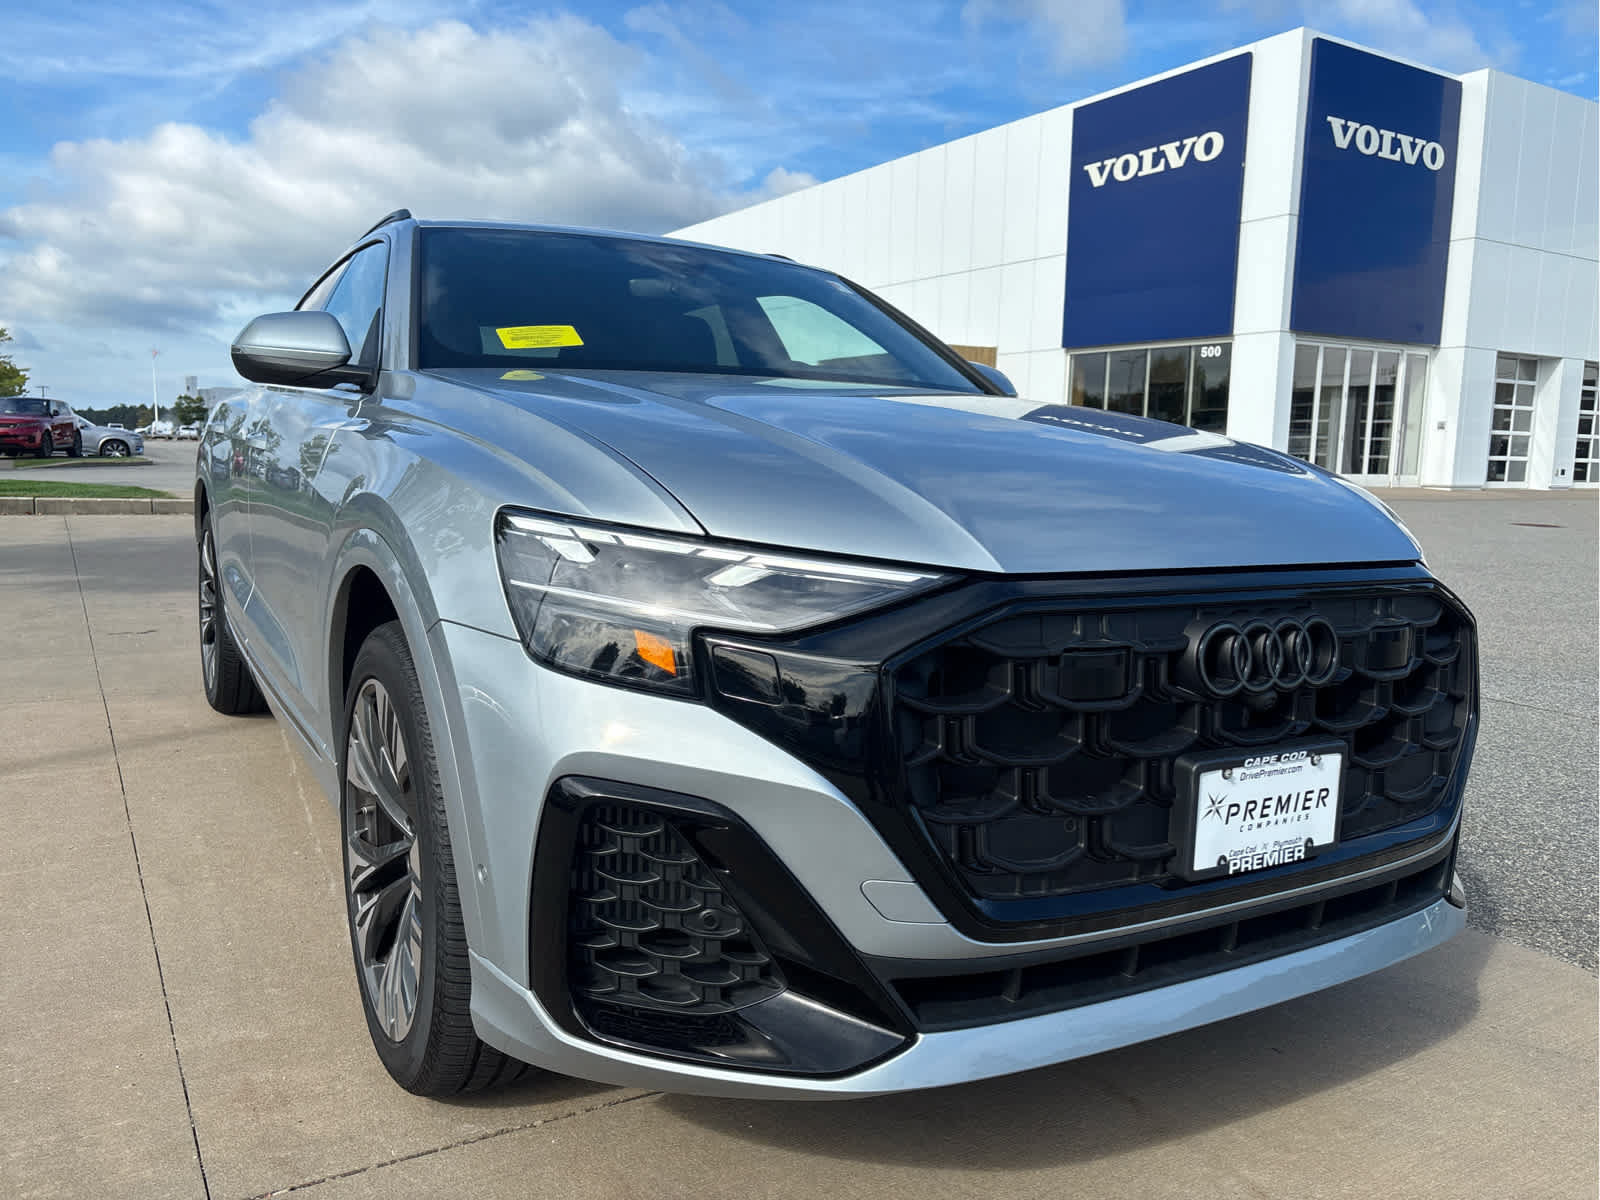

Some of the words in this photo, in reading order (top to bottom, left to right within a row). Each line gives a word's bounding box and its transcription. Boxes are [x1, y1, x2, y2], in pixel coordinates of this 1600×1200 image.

[1327, 115, 1445, 171] VOLVO
[1083, 131, 1225, 188] VOLVO
[1200, 345, 1221, 358] 500
[1244, 754, 1279, 768] CAPE
[1280, 750, 1308, 763] COD
[1240, 765, 1303, 782] DrivePremier.com
[1225, 787, 1330, 825] PREMIER
[1240, 813, 1310, 833] COMPANIES
[1228, 845, 1305, 875] PREMIER
